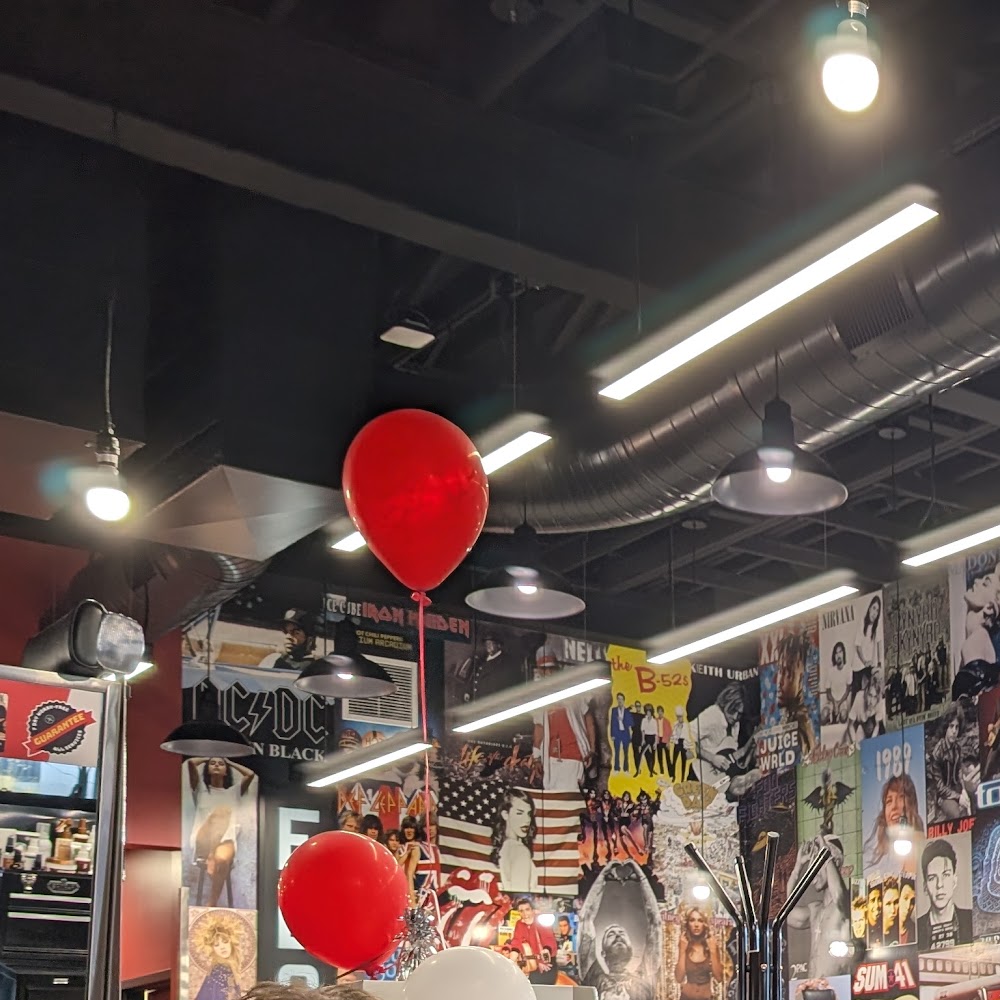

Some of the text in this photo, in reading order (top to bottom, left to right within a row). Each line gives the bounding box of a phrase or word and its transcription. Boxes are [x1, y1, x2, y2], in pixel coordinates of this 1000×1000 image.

[362, 602, 404, 627] IRON
[822, 604, 855, 630] NIRVANA
[612, 655, 634, 673] the
[691, 664, 760, 682] KEITH URBAN
[33, 712, 86, 746] GUARANTEE
[269, 743, 327, 763] BLACK
[760, 730, 798, 753] JUICE
[760, 750, 796, 773] WRLD
[876, 742, 912, 782] 1989
[927, 821, 954, 839] BILLY
[853, 959, 917, 995] SUM 41
